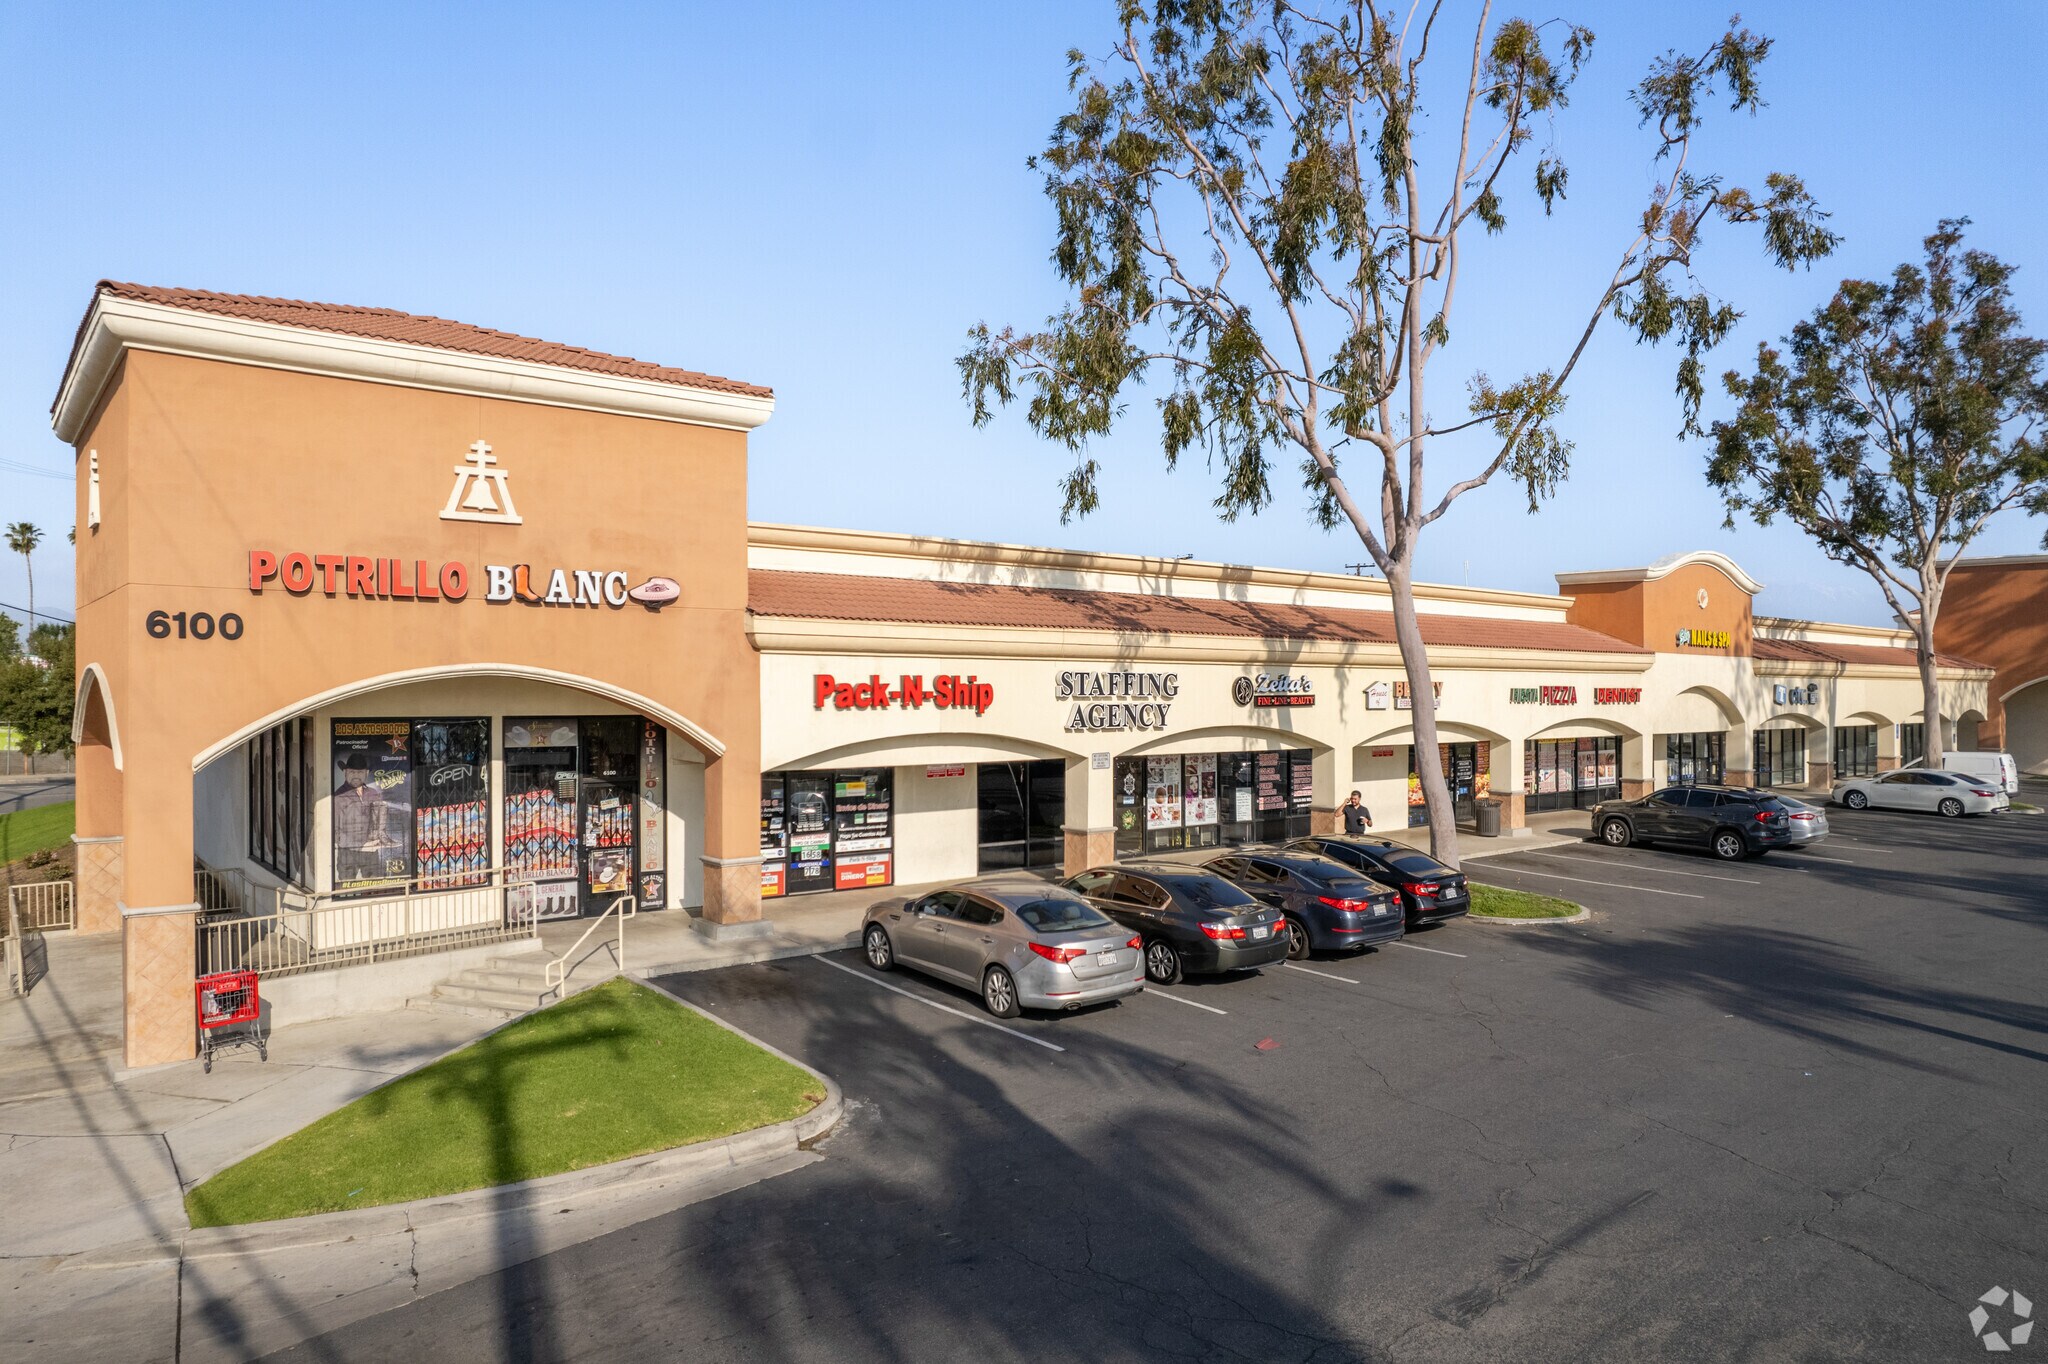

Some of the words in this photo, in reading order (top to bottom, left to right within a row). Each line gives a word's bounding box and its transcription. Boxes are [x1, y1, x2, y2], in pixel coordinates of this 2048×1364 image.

[249, 549, 469, 600] POTRILLO
[146, 610, 244, 640] 6100
[1690, 629, 1712, 647] NAILS
[1719, 631, 1731, 648] SPA
[1057, 671, 1180, 699] STAFFING
[814, 674, 994, 716] Pack-N-Ship
[1290, 697, 1314, 705] BEAUTY
[1541, 686, 1578, 705] PIZZA
[1596, 688, 1642, 703] DENTIST
[1068, 703, 1171, 730] AGENCY
[335, 723, 353, 736] LOS
[353, 723, 381, 736] ALTOS
[381, 722, 411, 735] BOOTS
[431, 765, 473, 786] OPEN
[645, 820, 658, 869] BLANCO
[546, 868, 573, 877] BLANCO
[841, 873, 865, 881] DINERO
[541, 884, 566, 894] GENERAL
